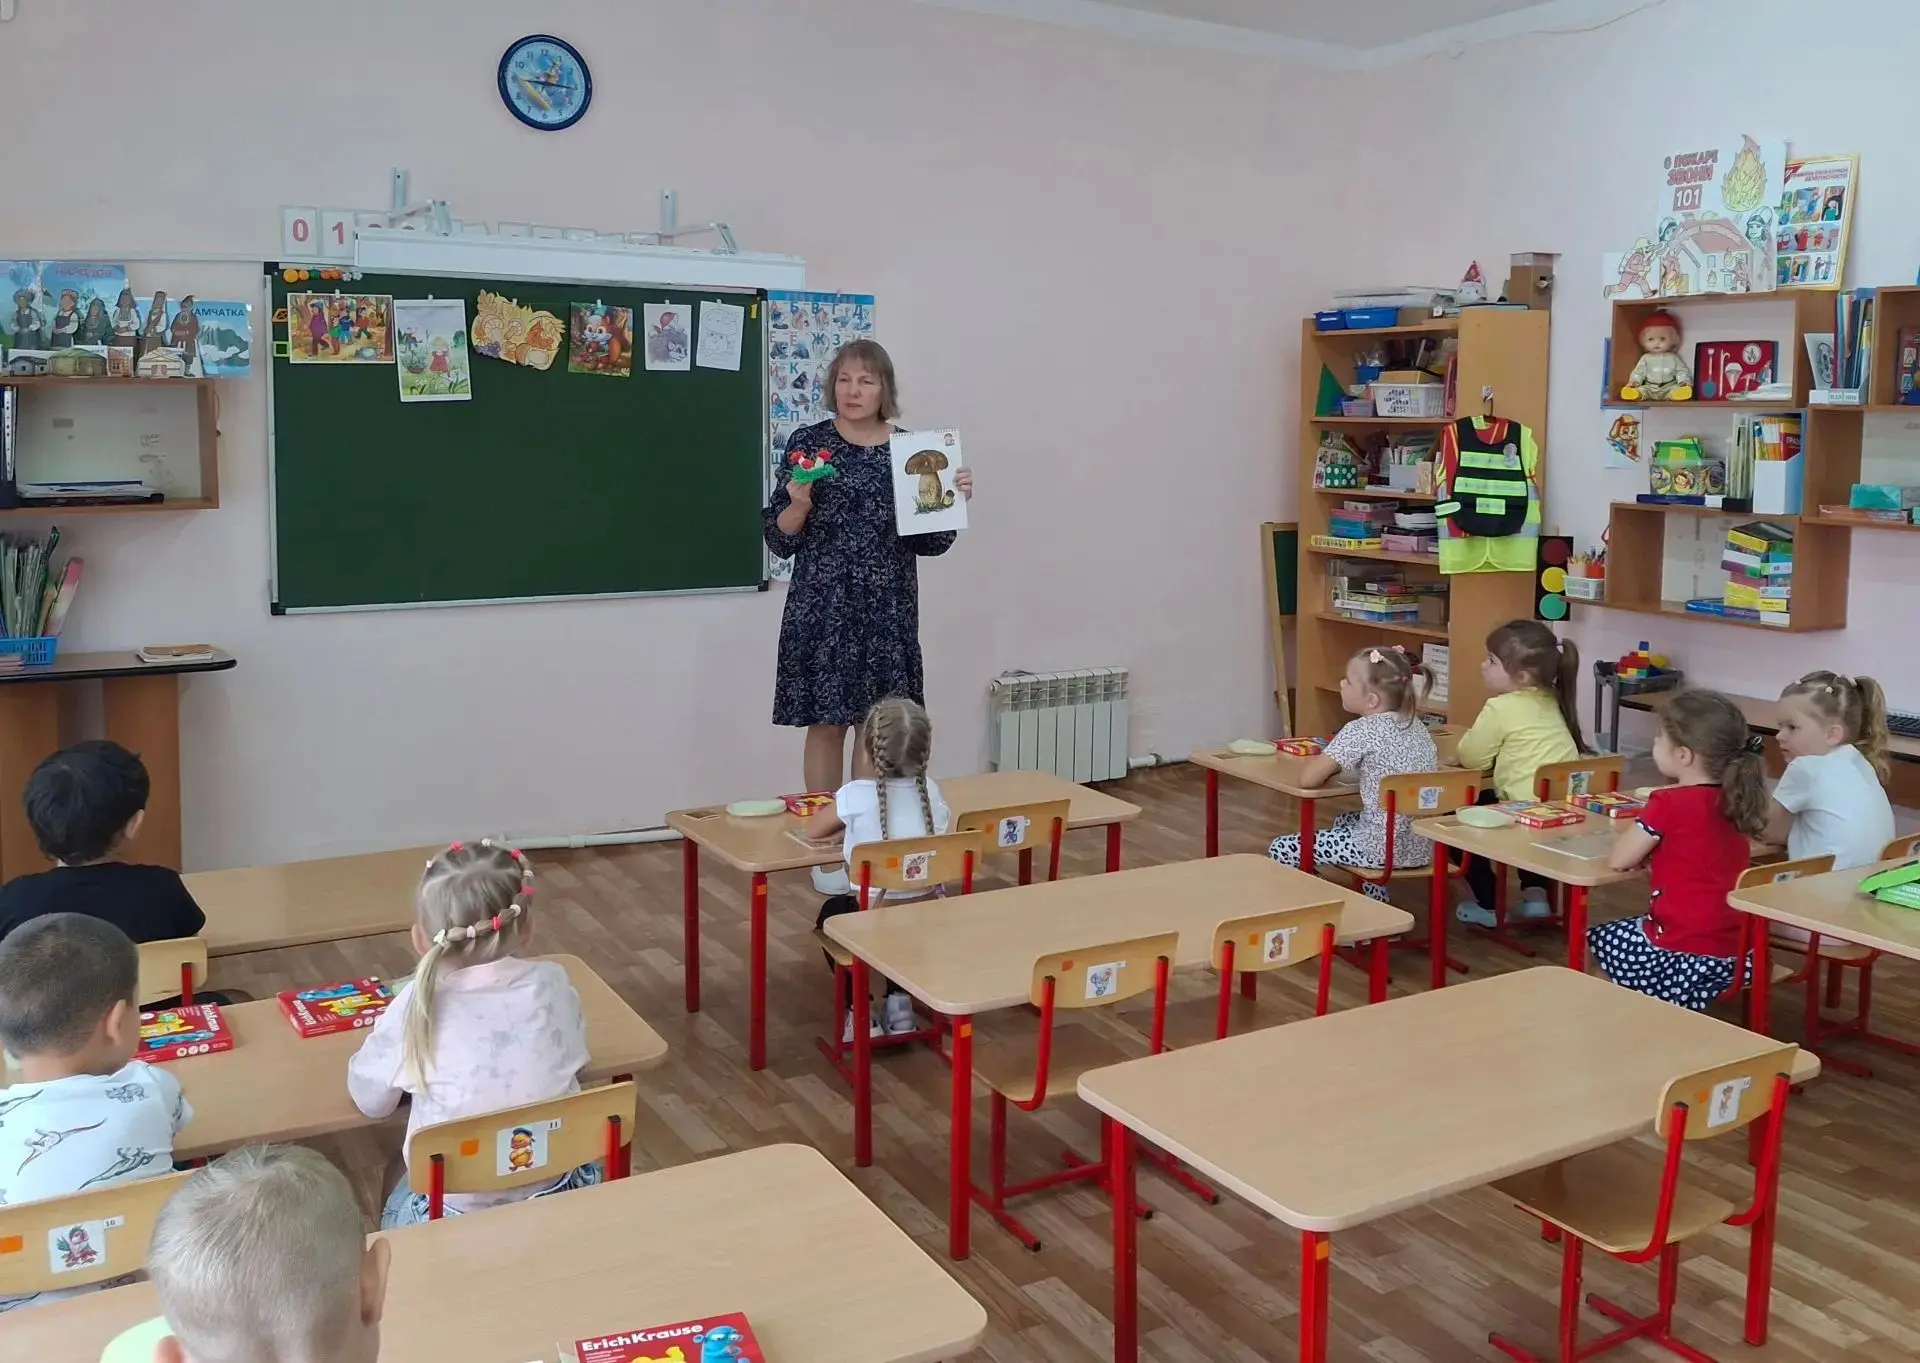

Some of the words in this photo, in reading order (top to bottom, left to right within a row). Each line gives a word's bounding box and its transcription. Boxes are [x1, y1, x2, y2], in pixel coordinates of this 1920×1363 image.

[515, 61, 525, 69] 10
[1667, 164, 1714, 186] ЗВОНИ
[1675, 187, 1701, 208] 101
[292, 219, 309, 242] 0
[331, 221, 344, 244] 1
[190, 308, 245, 317] АМЧАТКА
[770, 301, 779, 312] А
[790, 302, 799, 313] Б
[811, 302, 820, 315] В
[832, 303, 839, 315] Г
[853, 304, 865, 319] Д
[811, 333, 825, 346] Ж
[832, 334, 841, 345] З
[790, 362, 799, 374] К
[791, 410, 799, 422] П
[771, 422, 780, 434] У
[549, 1121, 558, 1129] 11
[105, 1219, 116, 1227] 10
[581, 1324, 704, 1352] ErichKrause
